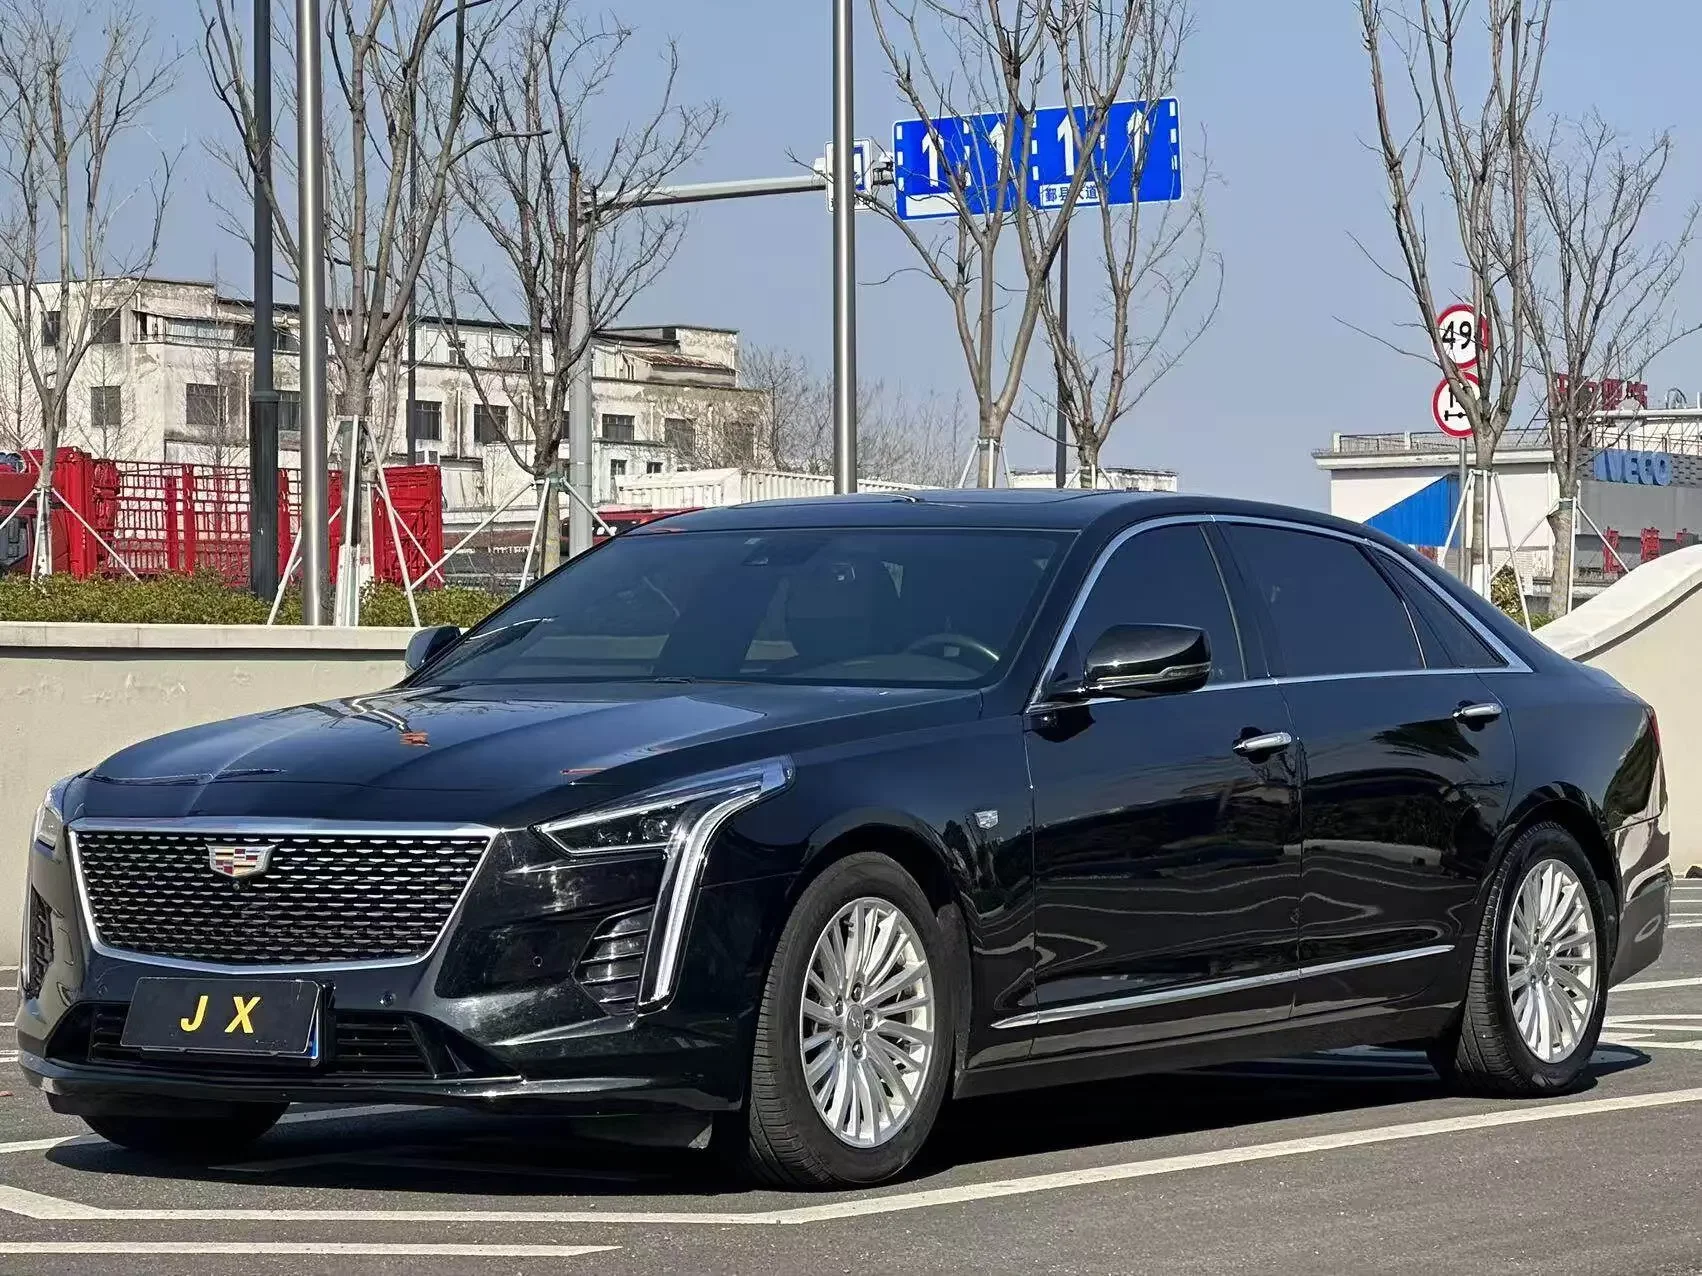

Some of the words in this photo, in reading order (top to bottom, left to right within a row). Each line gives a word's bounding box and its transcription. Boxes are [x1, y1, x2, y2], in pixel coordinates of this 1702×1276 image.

[1442, 321, 1472, 350] 49
[1594, 449, 1671, 486] IVECO
[180, 995, 209, 1032] J
[224, 996, 262, 1034] X
